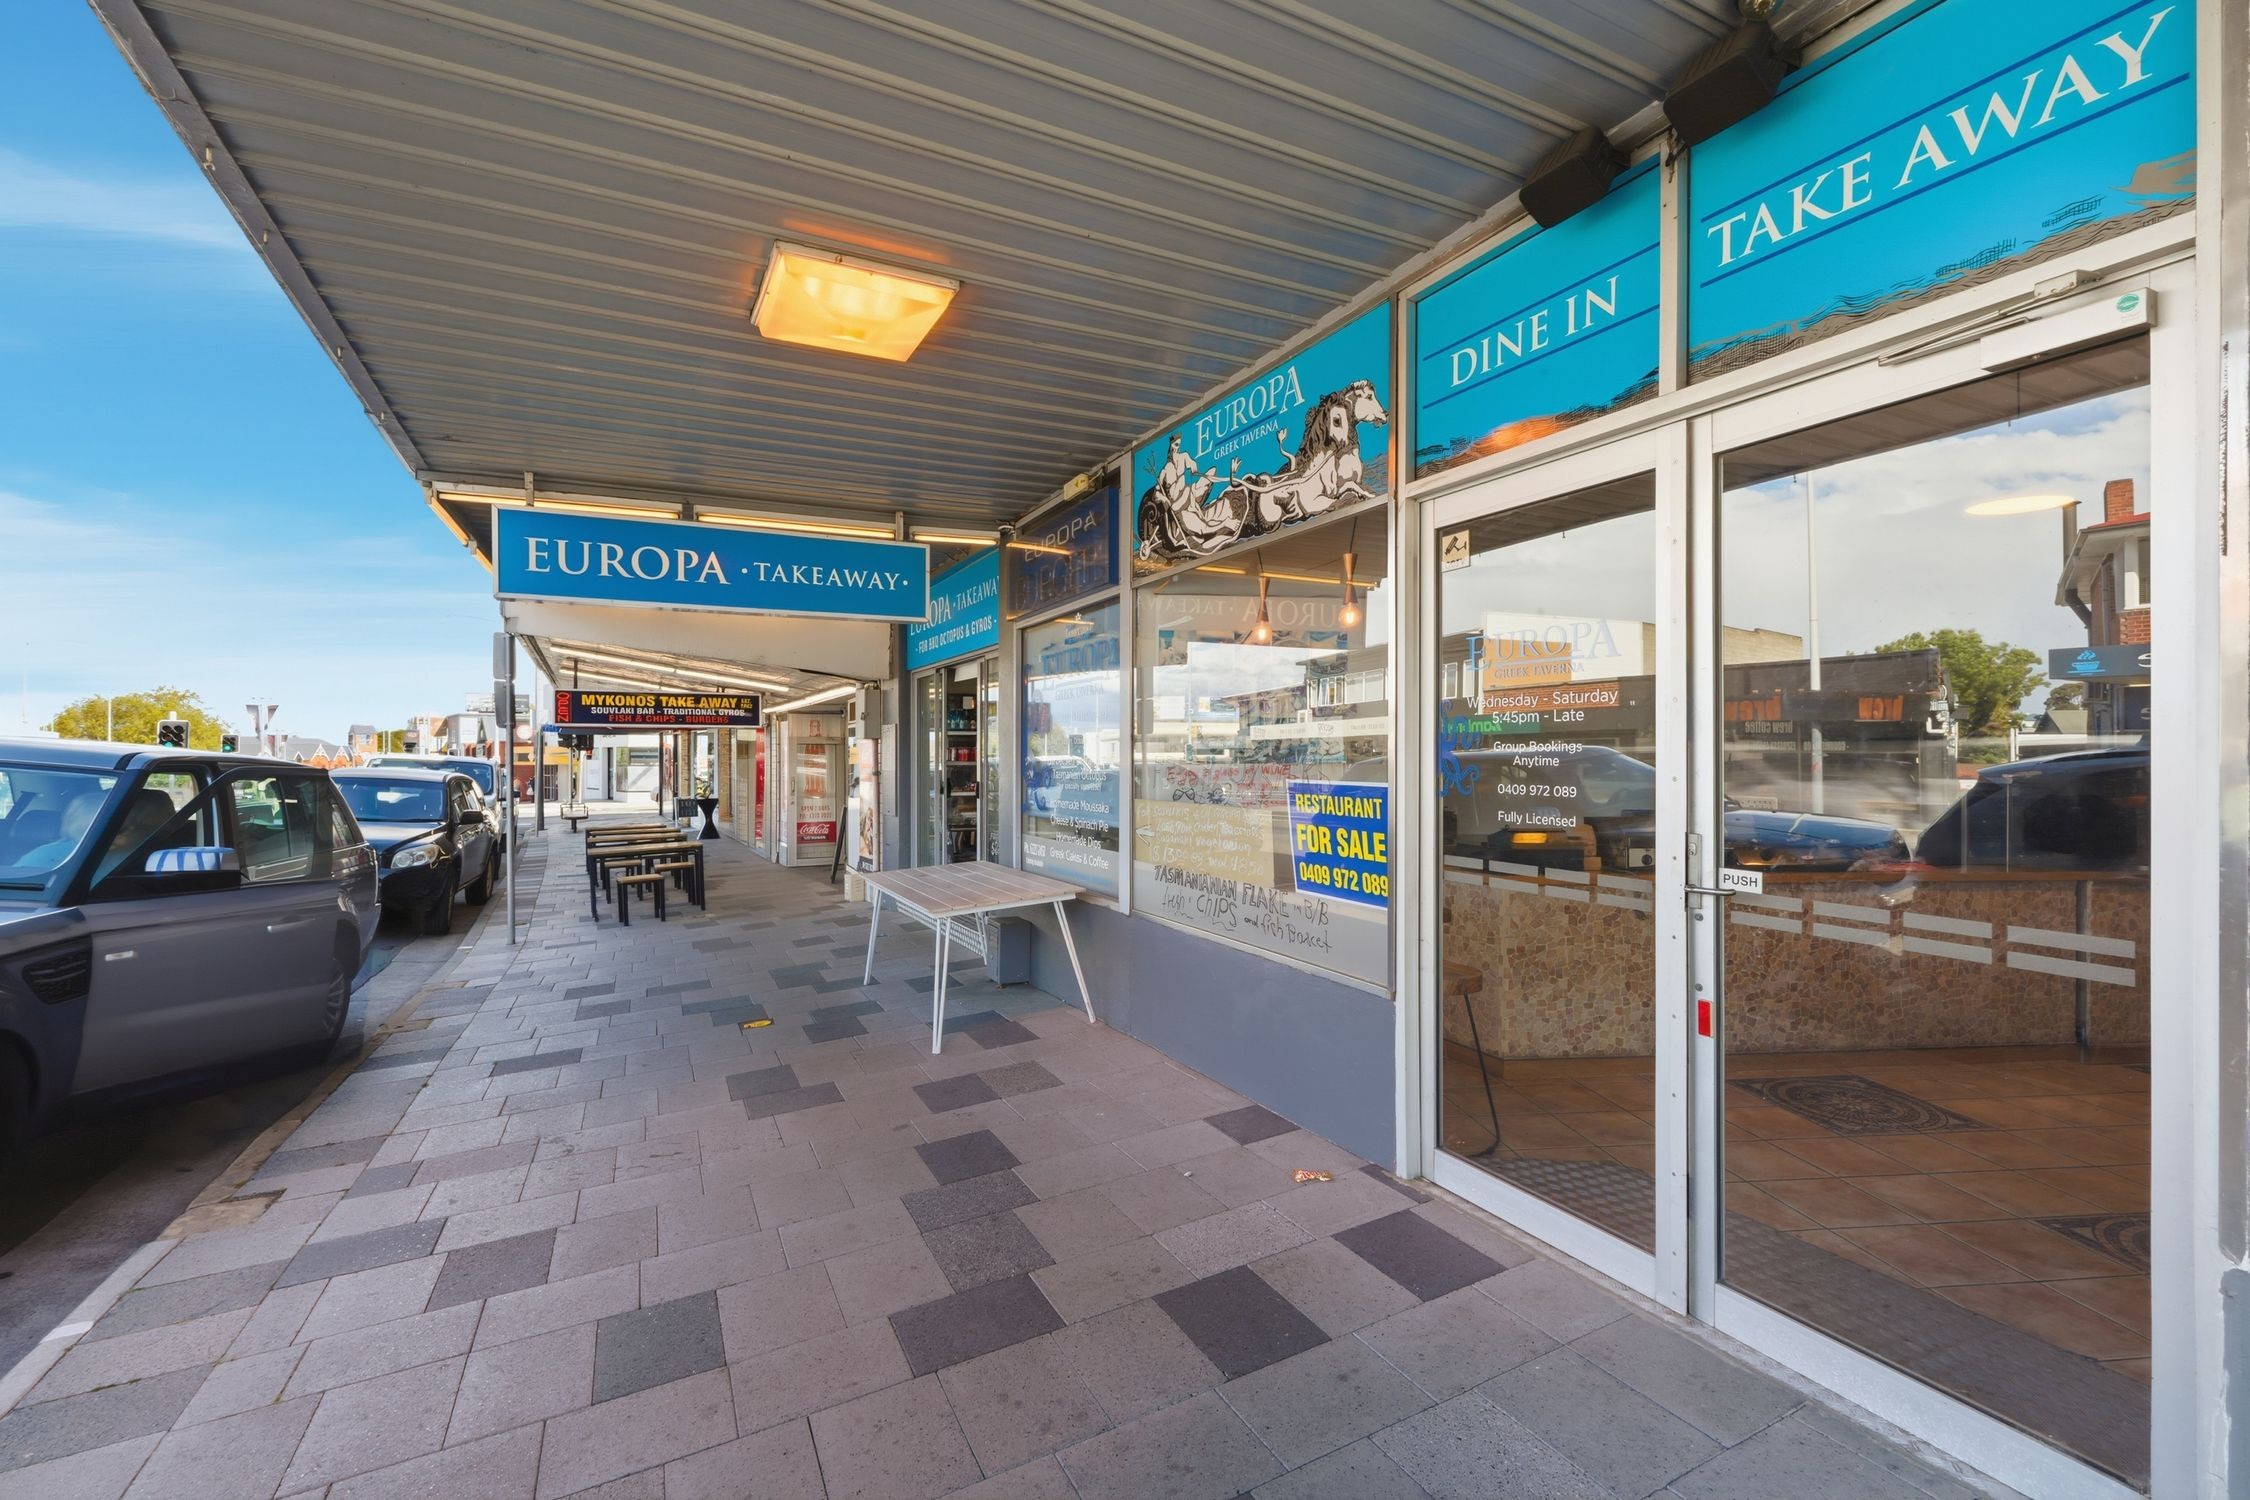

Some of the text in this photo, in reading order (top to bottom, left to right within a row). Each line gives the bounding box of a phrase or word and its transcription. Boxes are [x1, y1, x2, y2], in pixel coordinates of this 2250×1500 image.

[1706, 5, 2175, 268] TAKE AWAY
[1450, 275, 1620, 387] DINE IN
[1194, 366, 1306, 460] EUROPA
[1213, 419, 1279, 461] GREEK TAVERNA
[524, 535, 900, 591] EUROPA TAKEAWAY
[939, 626, 964, 646] OCTOPUS
[965, 624, 971, 638] &
[971, 616, 993, 635] GYROS
[1466, 617, 1622, 672] EUROPA
[1494, 662, 1585, 680] GREEK TAVERNA
[581, 694, 656, 707] MYKONOS
[660, 696, 695, 708] TAKE
[699, 697, 738, 709] AWAY
[1467, 695, 1539, 709] Wednesday
[1553, 689, 1618, 706] Saturday
[591, 706, 635, 714] SOUVLAKI
[663, 708, 716, 716] TRADITIONAL
[608, 714, 633, 722] FISH
[646, 715, 676, 723] CHIPS
[1492, 710, 1540, 725] 5:45pm
[1553, 709, 1584, 722] Late
[1493, 740, 1583, 755] Group Bookings
[1513, 755, 1560, 769] Anytime
[1497, 784, 1577, 798] 0409 972 089
[1080, 800, 1110, 814] Moussaka
[1295, 793, 1383, 819] RESTAURANT
[1050, 814, 1068, 827] Cheese
[1075, 818, 1098, 831] Spinach
[1098, 820, 1109, 832] Pie
[1497, 811, 1576, 828] Fully Licensed
[1087, 836, 1102, 850] Dips
[1297, 824, 1333, 855] FOR
[1336, 830, 1387, 863] SALE
[1049, 847, 1065, 861] Greek
[1065, 849, 1083, 865] Cakes
[1083, 853, 1088, 866] &
[1088, 854, 1109, 870] Coffee
[1299, 861, 1388, 897] 0409 972 089
[1723, 873, 1758, 888] PUSH
[1241, 883, 1290, 918] FLAKE
[1259, 914, 1284, 940] fish
